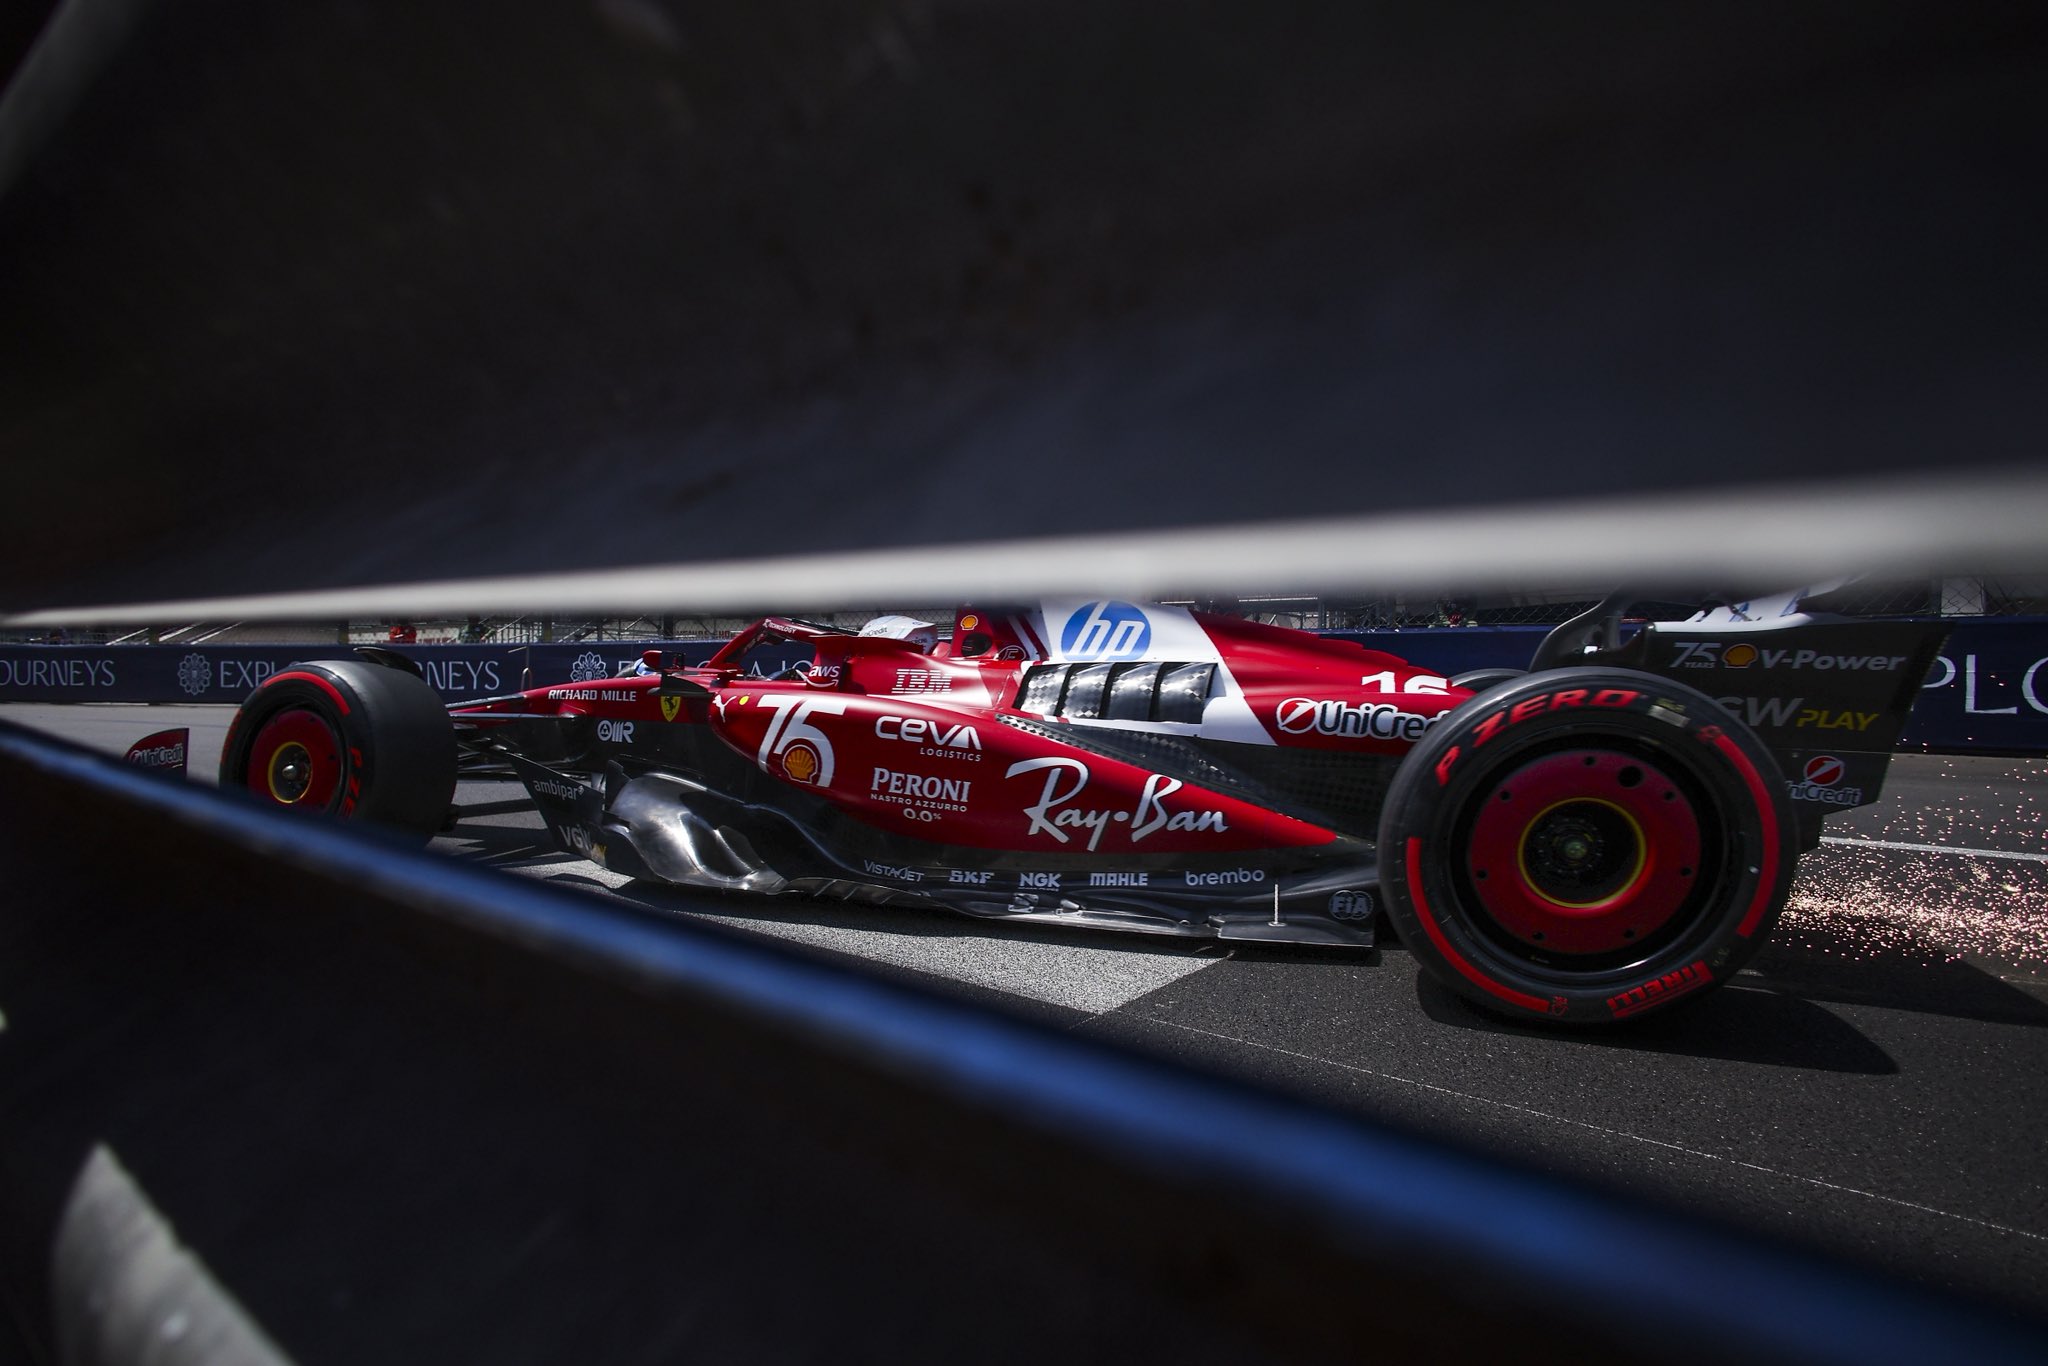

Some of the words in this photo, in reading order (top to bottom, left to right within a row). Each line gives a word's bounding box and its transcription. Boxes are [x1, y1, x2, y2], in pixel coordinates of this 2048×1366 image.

[1068, 600, 1146, 662] hp
[1669, 642, 1722, 669] 75
[1760, 649, 1907, 672] V-Power
[414, 660, 500, 690] NEYS
[808, 665, 841, 679] aws
[891, 668, 953, 695] IBM
[548, 689, 598, 701] RICHARD
[601, 690, 637, 702] MILLE
[1318, 701, 1440, 740] UniCre
[1795, 708, 1881, 732] PLAY
[756, 694, 850, 788] 75
[1434, 745, 1461, 787] P
[1471, 687, 1643, 749] ZERO
[919, 747, 982, 762] LOGISTICS
[532, 779, 579, 801] ambipar
[870, 767, 972, 803] PERONI
[1785, 778, 1864, 806] niCredit
[870, 793, 913, 805] NASTRO
[914, 798, 968, 813] AZZURRO
[902, 807, 942, 823] 0.0%
[948, 870, 996, 884] SKF
[1019, 872, 1062, 888] NGK
[1089, 872, 1149, 887] MAHLE
[1185, 867, 1266, 886] brembo
[1606, 959, 1715, 1018] PIRELLI
